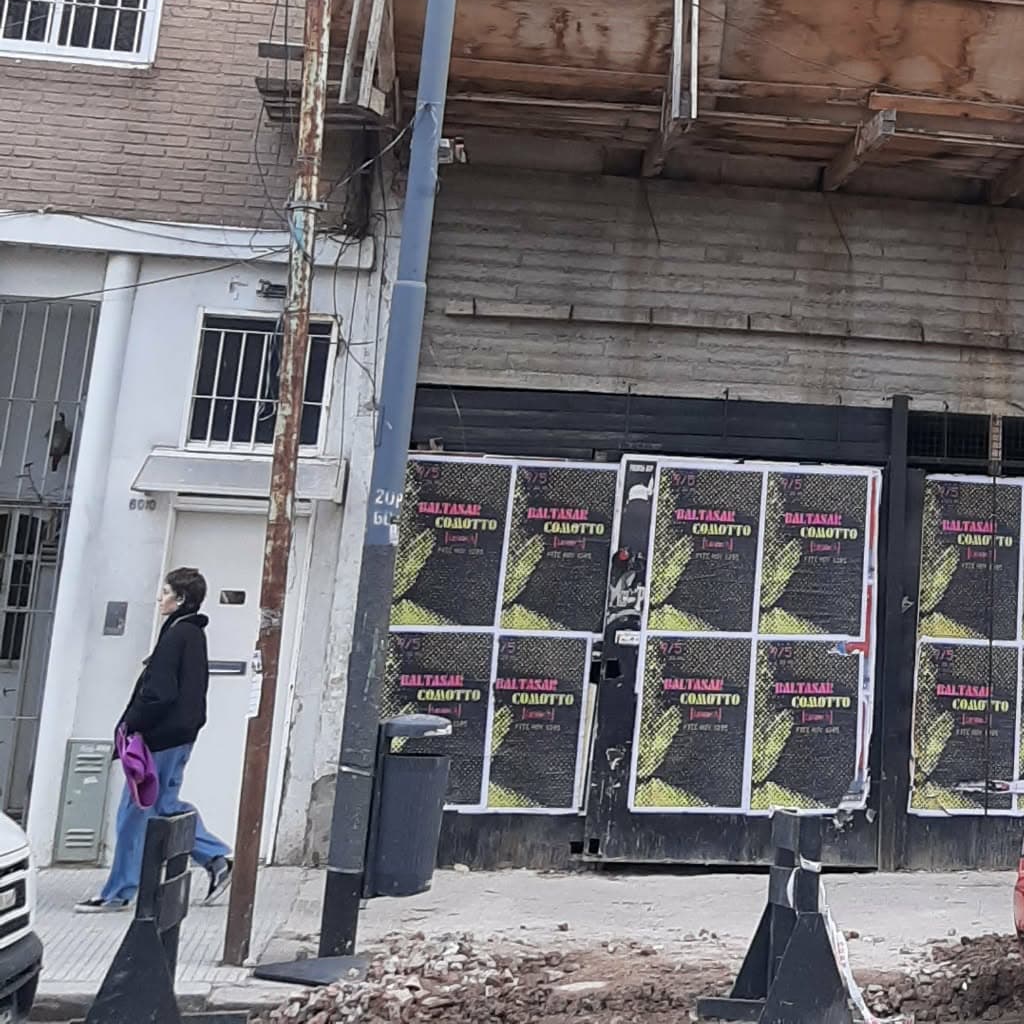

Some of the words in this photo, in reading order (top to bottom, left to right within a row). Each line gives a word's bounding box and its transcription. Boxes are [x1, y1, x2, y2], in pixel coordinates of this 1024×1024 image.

[418, 502, 481, 516] BALTASAR
[527, 507, 588, 521] BALTASAR
[676, 509, 735, 523] BALTASAR
[435, 517, 498, 531] COMOTTO
[784, 512, 842, 526] BALTASAR
[543, 521, 604, 535] COMOTTO
[692, 523, 751, 537] COMOTTO
[800, 526, 858, 539] COMOTTO
[957, 534, 1013, 547] COMOTO
[401, 673, 464, 687] BALTASAR
[496, 678, 559, 692] BALTASAR
[664, 678, 723, 692] BALTASAR
[417, 689, 481, 702] COMOTTO
[775, 682, 833, 695] BALTASAR
[512, 693, 574, 706] COMOTTO
[680, 693, 741, 706] COMOTTO
[791, 696, 851, 709] COMOTTO
[952, 698, 1009, 713] COMOTO
